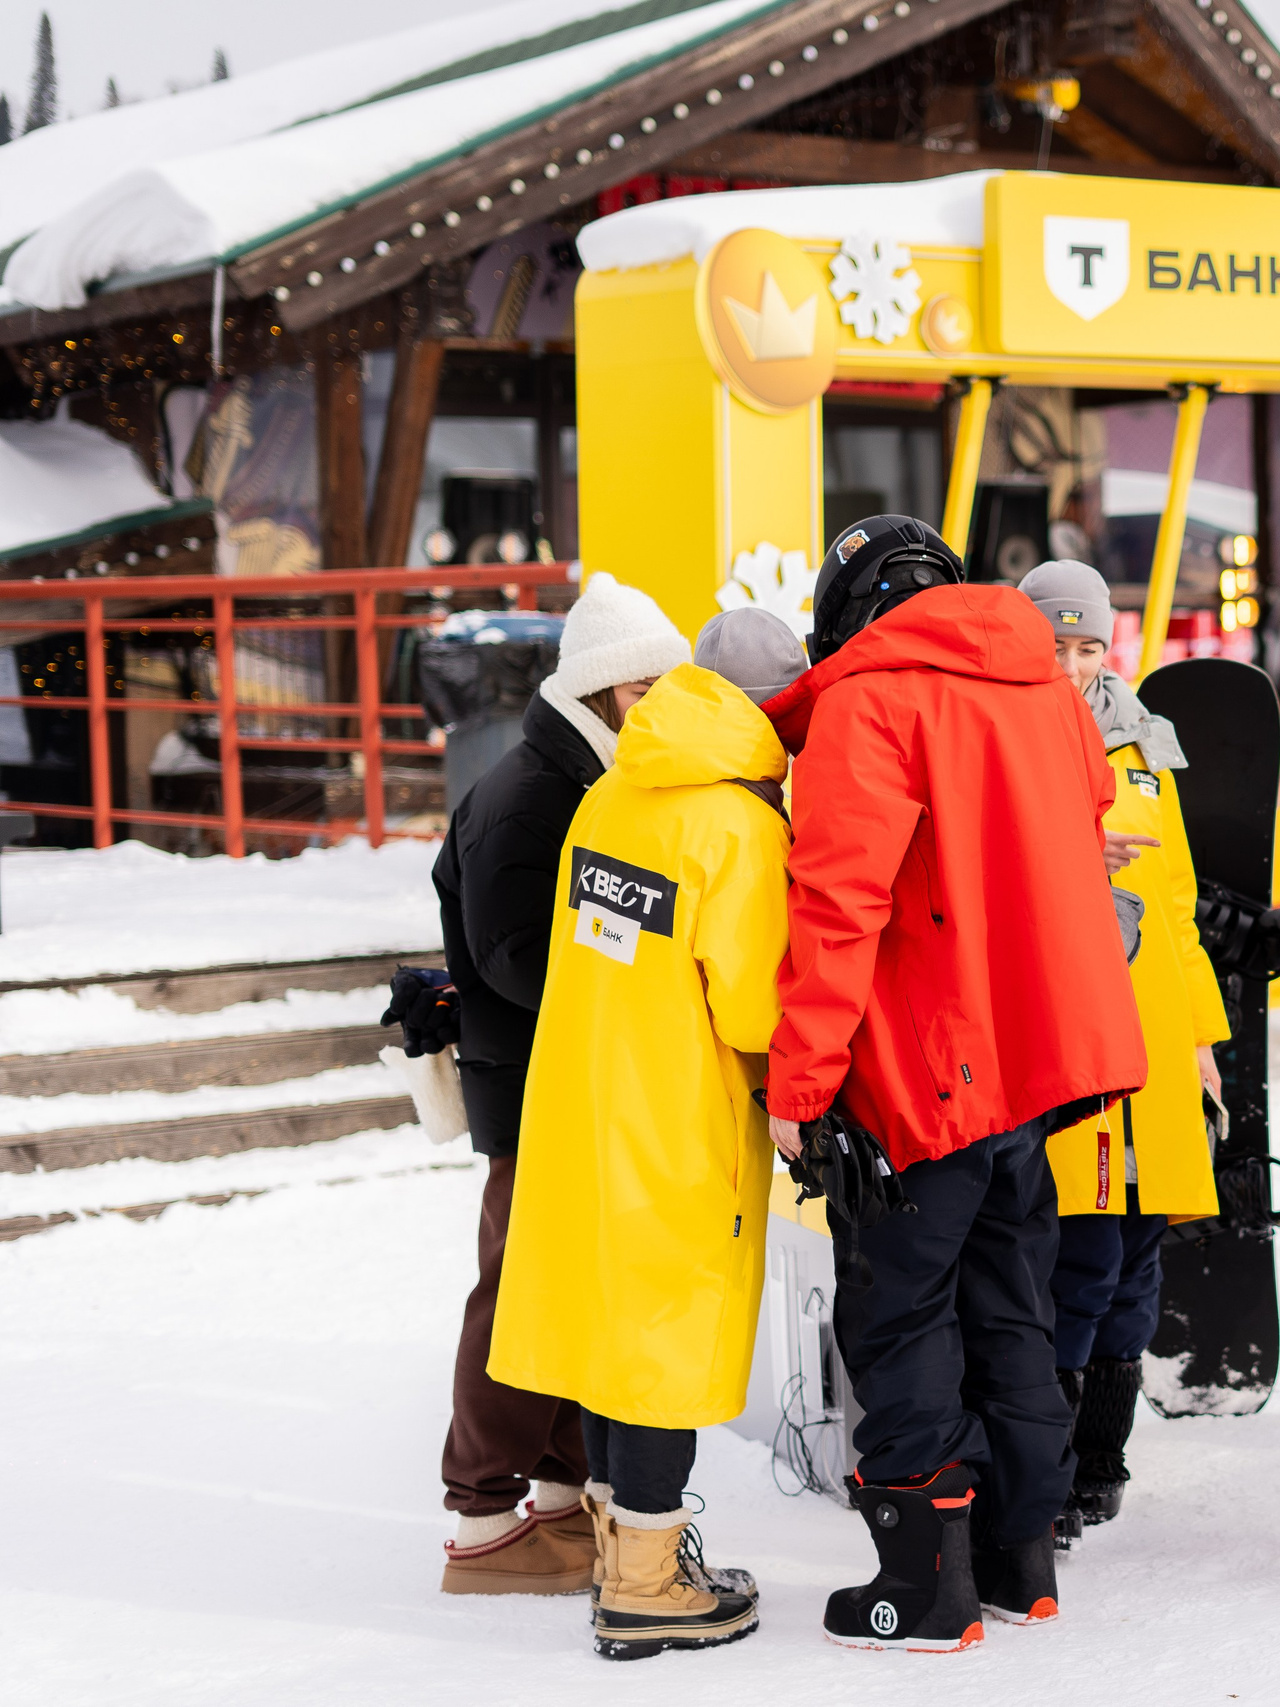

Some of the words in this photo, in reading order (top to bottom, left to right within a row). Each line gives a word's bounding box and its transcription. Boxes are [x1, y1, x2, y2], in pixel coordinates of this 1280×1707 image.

[1070, 246, 1104, 286] Т
[580, 864, 662, 914] КВЕСТ
[602, 927, 623, 943] БАНК
[877, 1606, 892, 1630] 13
